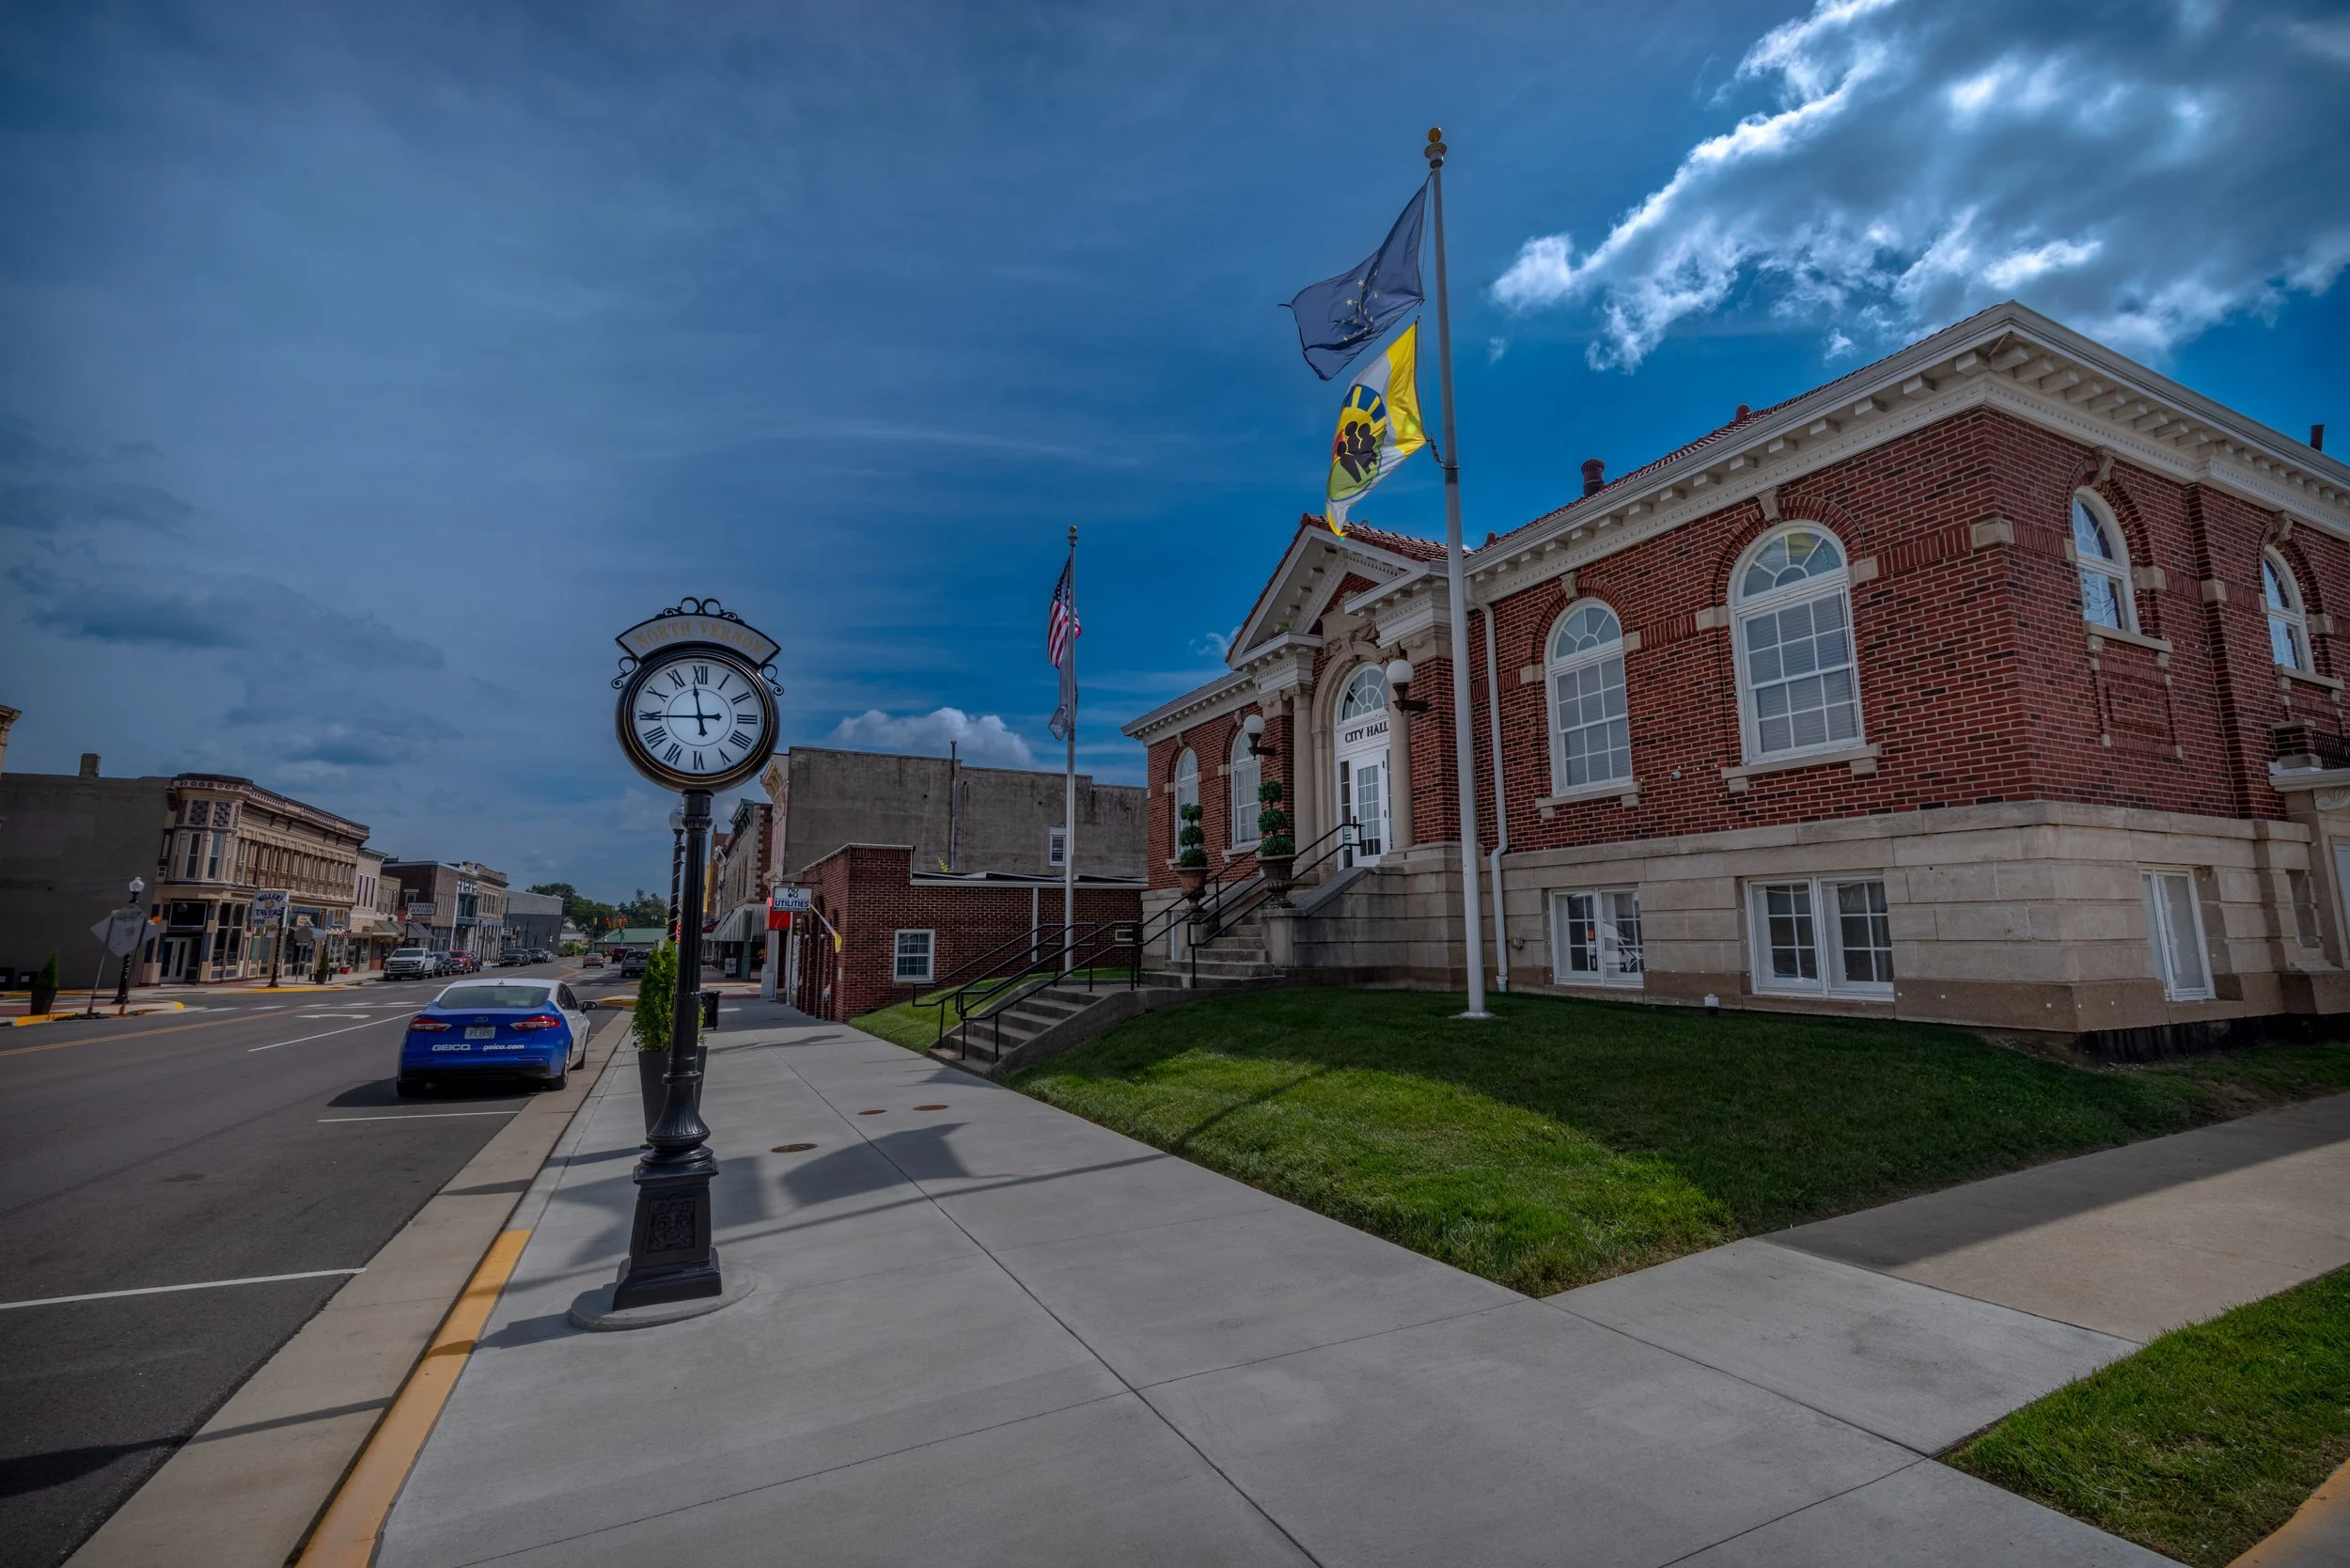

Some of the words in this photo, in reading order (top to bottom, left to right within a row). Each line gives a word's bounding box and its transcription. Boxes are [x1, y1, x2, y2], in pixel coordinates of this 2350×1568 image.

[634, 621, 691, 649] NORTH
[699, 621, 764, 655] VERNON
[666, 668, 686, 691] XI
[693, 666, 709, 685] XII
[718, 673, 731, 691] I
[647, 685, 669, 703] X
[730, 691, 752, 705] II
[737, 713, 758, 726] III
[643, 726, 668, 750] VIII
[728, 729, 753, 751] IIII
[1344, 728, 1364, 744] CITY
[1367, 721, 1389, 737] HALL
[662, 743, 683, 766] VII
[693, 750, 705, 771] VI
[718, 747, 733, 766] V
[482, 1043, 525, 1052] geico.com
